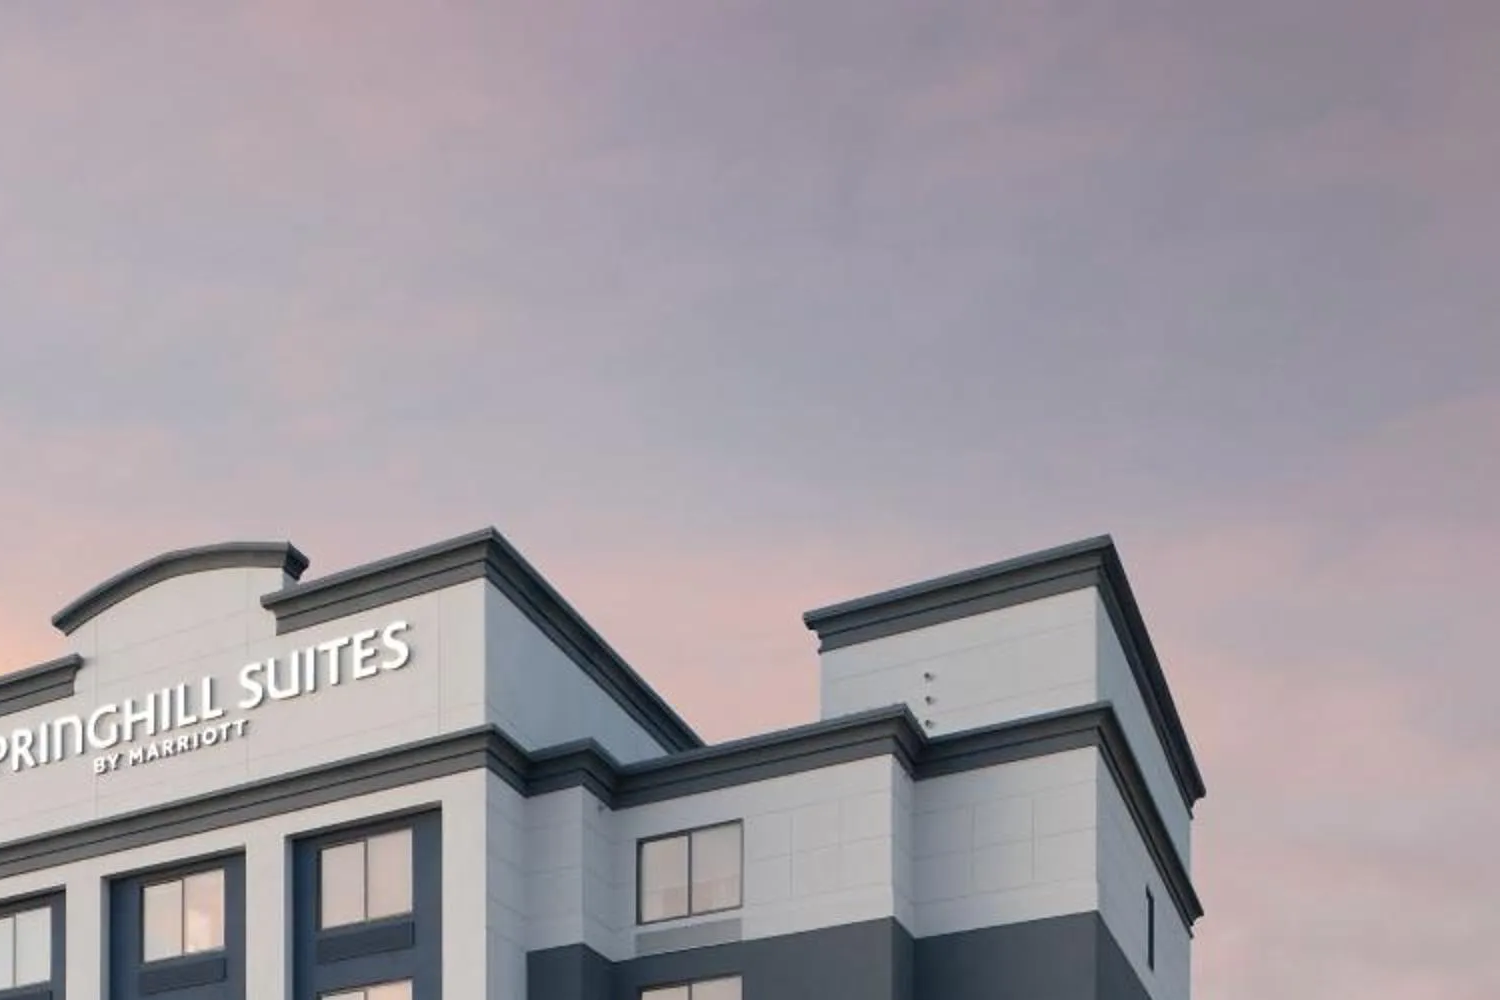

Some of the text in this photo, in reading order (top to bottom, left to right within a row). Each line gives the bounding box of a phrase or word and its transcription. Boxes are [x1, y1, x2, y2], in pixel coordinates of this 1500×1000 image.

[238, 620, 410, 709] SUITES
[93, 719, 248, 774] BY MARRIOTT
